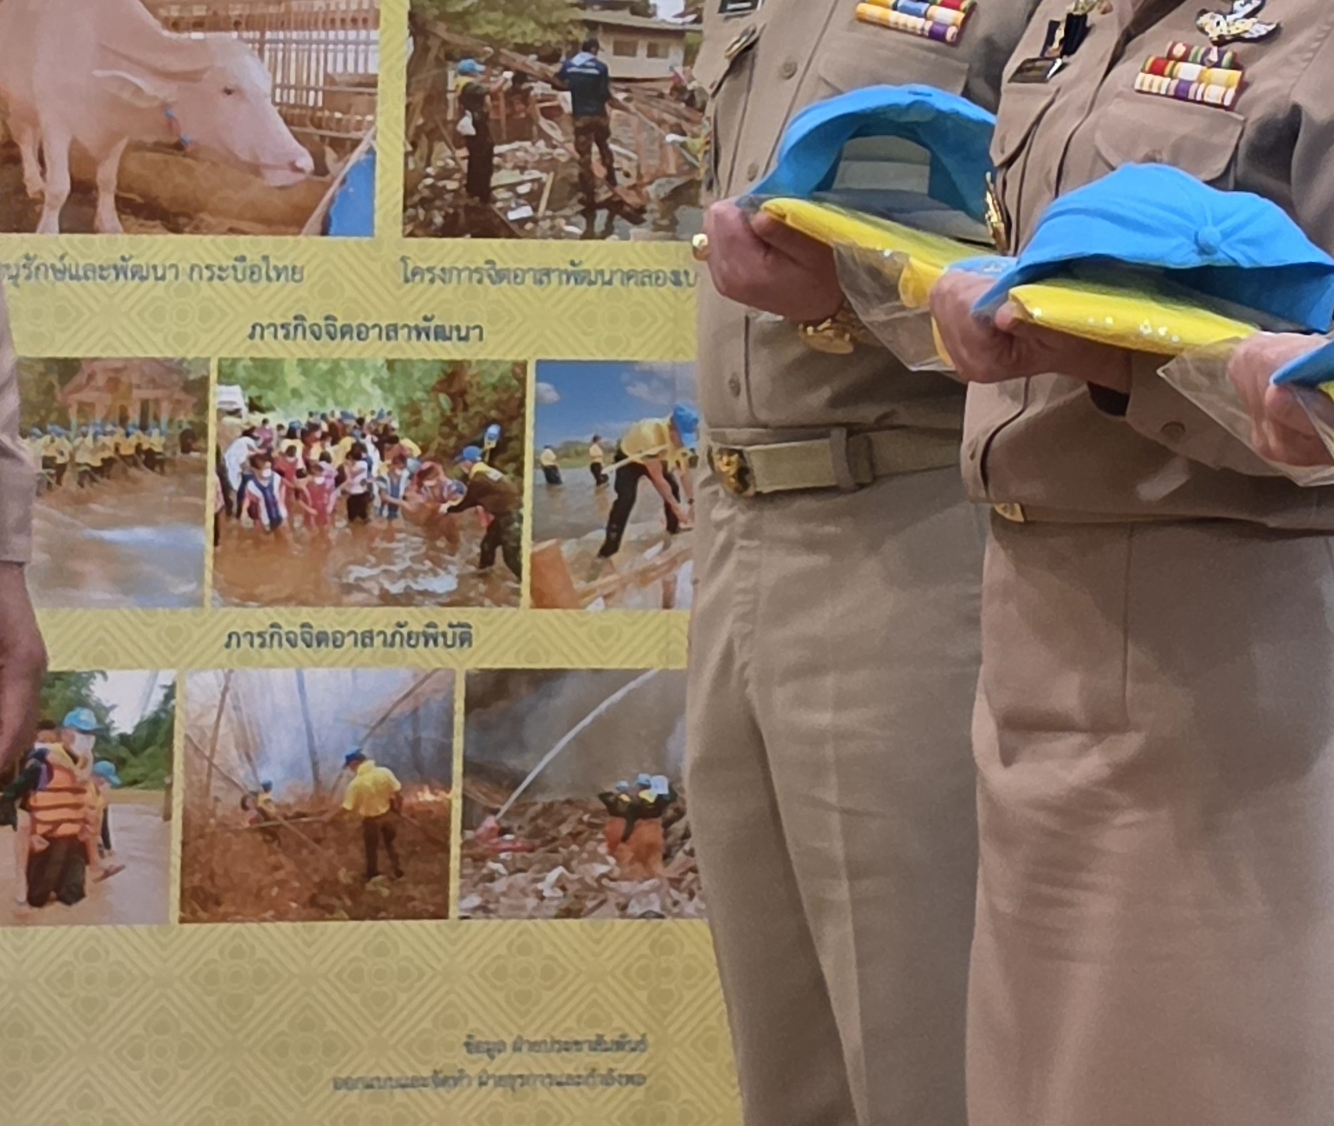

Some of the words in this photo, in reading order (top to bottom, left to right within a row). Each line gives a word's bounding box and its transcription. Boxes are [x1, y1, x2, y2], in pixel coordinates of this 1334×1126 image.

[188, 254, 305, 284] กระบือไทย
[247, 313, 484, 343] ภารกิจจิตอาสาพัฒนา
[223, 620, 474, 650] ภารกิจจิตอาสาภัยพิบัติ
